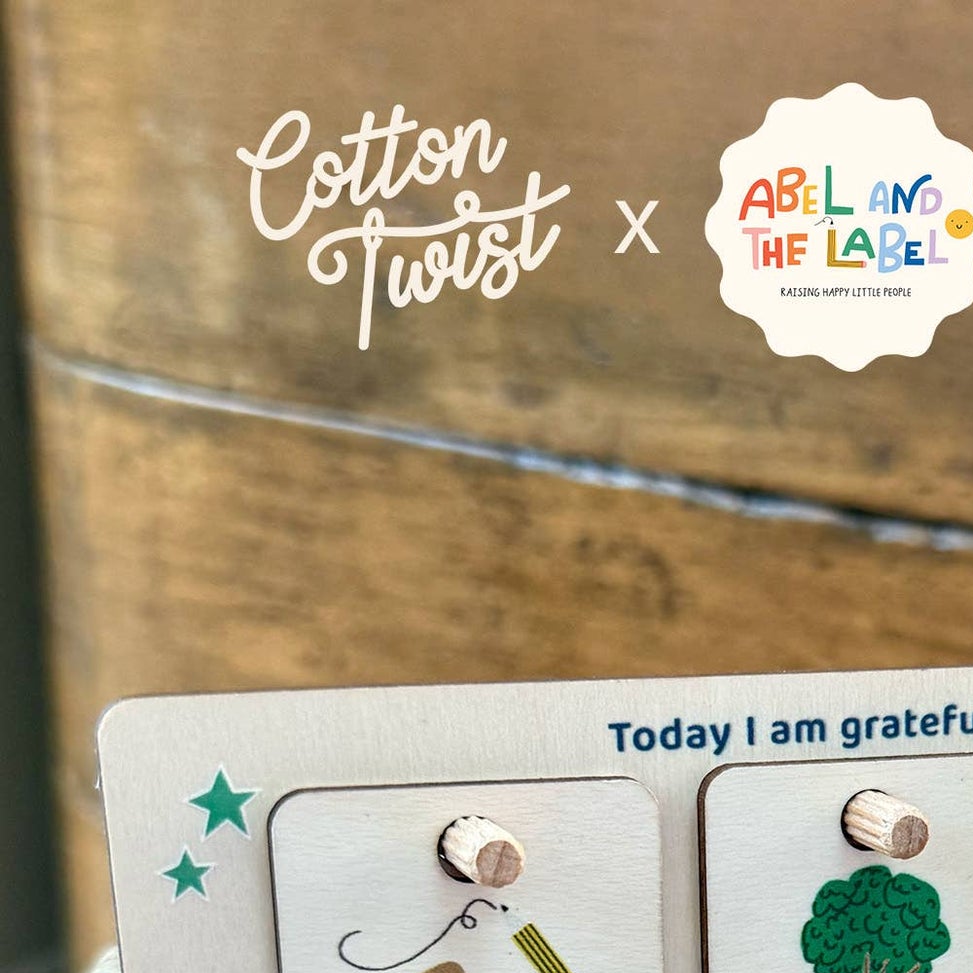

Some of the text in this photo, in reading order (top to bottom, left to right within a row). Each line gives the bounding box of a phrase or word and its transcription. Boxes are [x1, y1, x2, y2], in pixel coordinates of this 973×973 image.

[608, 717, 731, 756] Today
[747, 716, 755, 746] I
[770, 718, 826, 745] am
